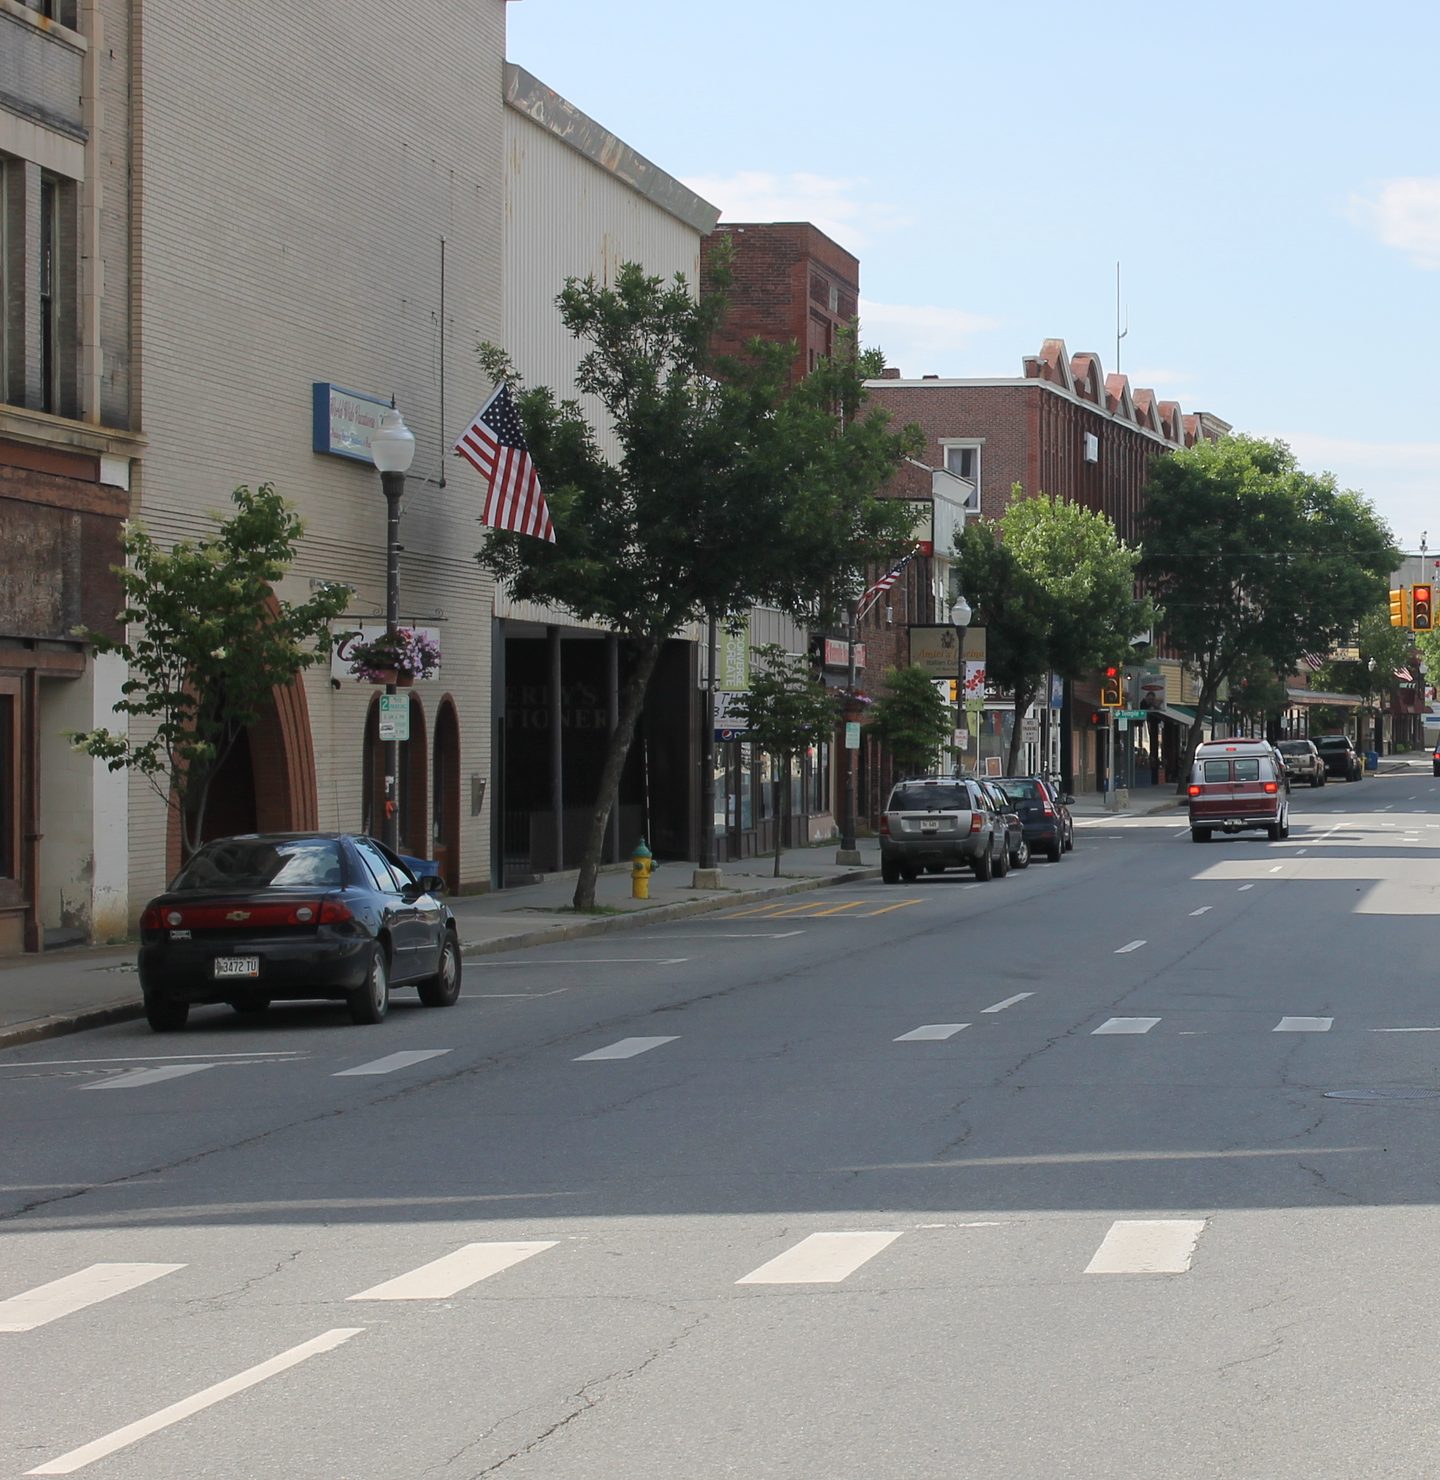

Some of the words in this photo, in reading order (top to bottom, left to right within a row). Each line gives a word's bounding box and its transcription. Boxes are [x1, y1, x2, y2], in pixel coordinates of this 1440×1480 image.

[382, 698, 389, 710] 2
[223, 960, 244, 973] 3472
[246, 960, 257, 972] TU
